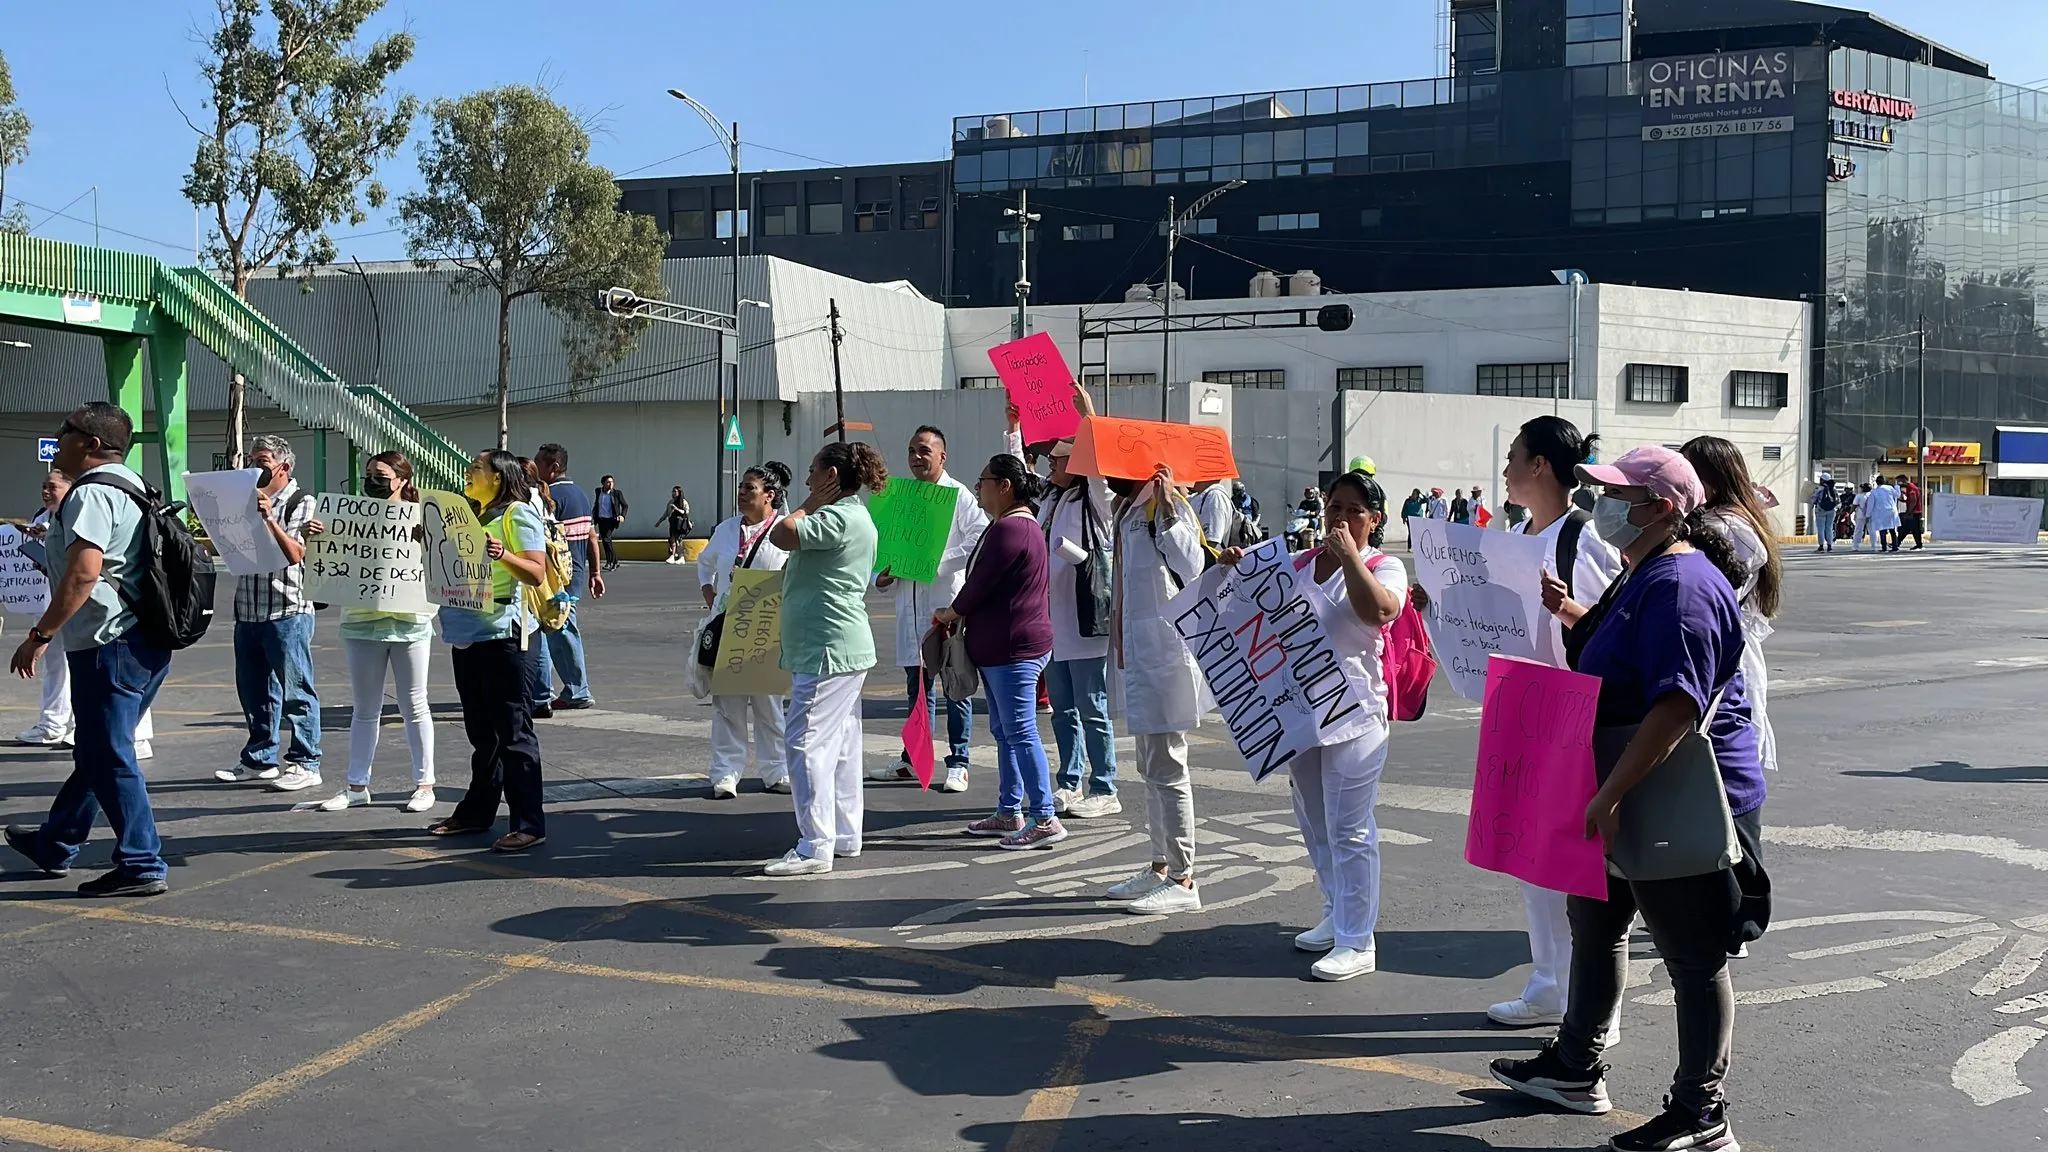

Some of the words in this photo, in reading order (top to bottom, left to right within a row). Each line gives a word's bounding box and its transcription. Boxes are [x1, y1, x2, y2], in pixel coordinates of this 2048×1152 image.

[1650, 52, 1787, 83] OFICINAS
[1650, 86, 1685, 108] EN
[1696, 79, 1785, 105] RENTA
[1671, 110, 1714, 120] Insurgentes
[1717, 108, 1739, 117] Norte
[1834, 91, 1917, 119] CERTANIUM
[1666, 126, 1687, 138] +52
[1690, 124, 1713, 137] (55)
[1717, 124, 1730, 135] 76
[1735, 122, 1747, 133] 18
[1752, 121, 1763, 132] 17
[1768, 119, 1782, 131] 56
[1001, 351, 1048, 375] Trabajadores
[1024, 377, 1044, 394] bajo
[1027, 394, 1067, 421] Protesta
[1926, 445, 1968, 462] DHL
[320, 496, 330, 513] A
[337, 498, 380, 516] POCO
[385, 504, 413, 520] EN
[445, 506, 469, 527] #NO
[310, 540, 410, 560] TAMBIEN
[457, 532, 474, 554] ES
[313, 558, 350, 578] $32
[360, 567, 385, 580] DE
[453, 559, 492, 581] CLAUDIA
[33, 593, 45, 603] YA
[359, 584, 396, 599] ??!!
[1467, 608, 1526, 640] trabajando
[1234, 611, 1288, 682] NO
[1235, 541, 1361, 730] BASIFICACION
[1479, 636, 1502, 651] base
[1174, 596, 1297, 782] EXPLOTACION
